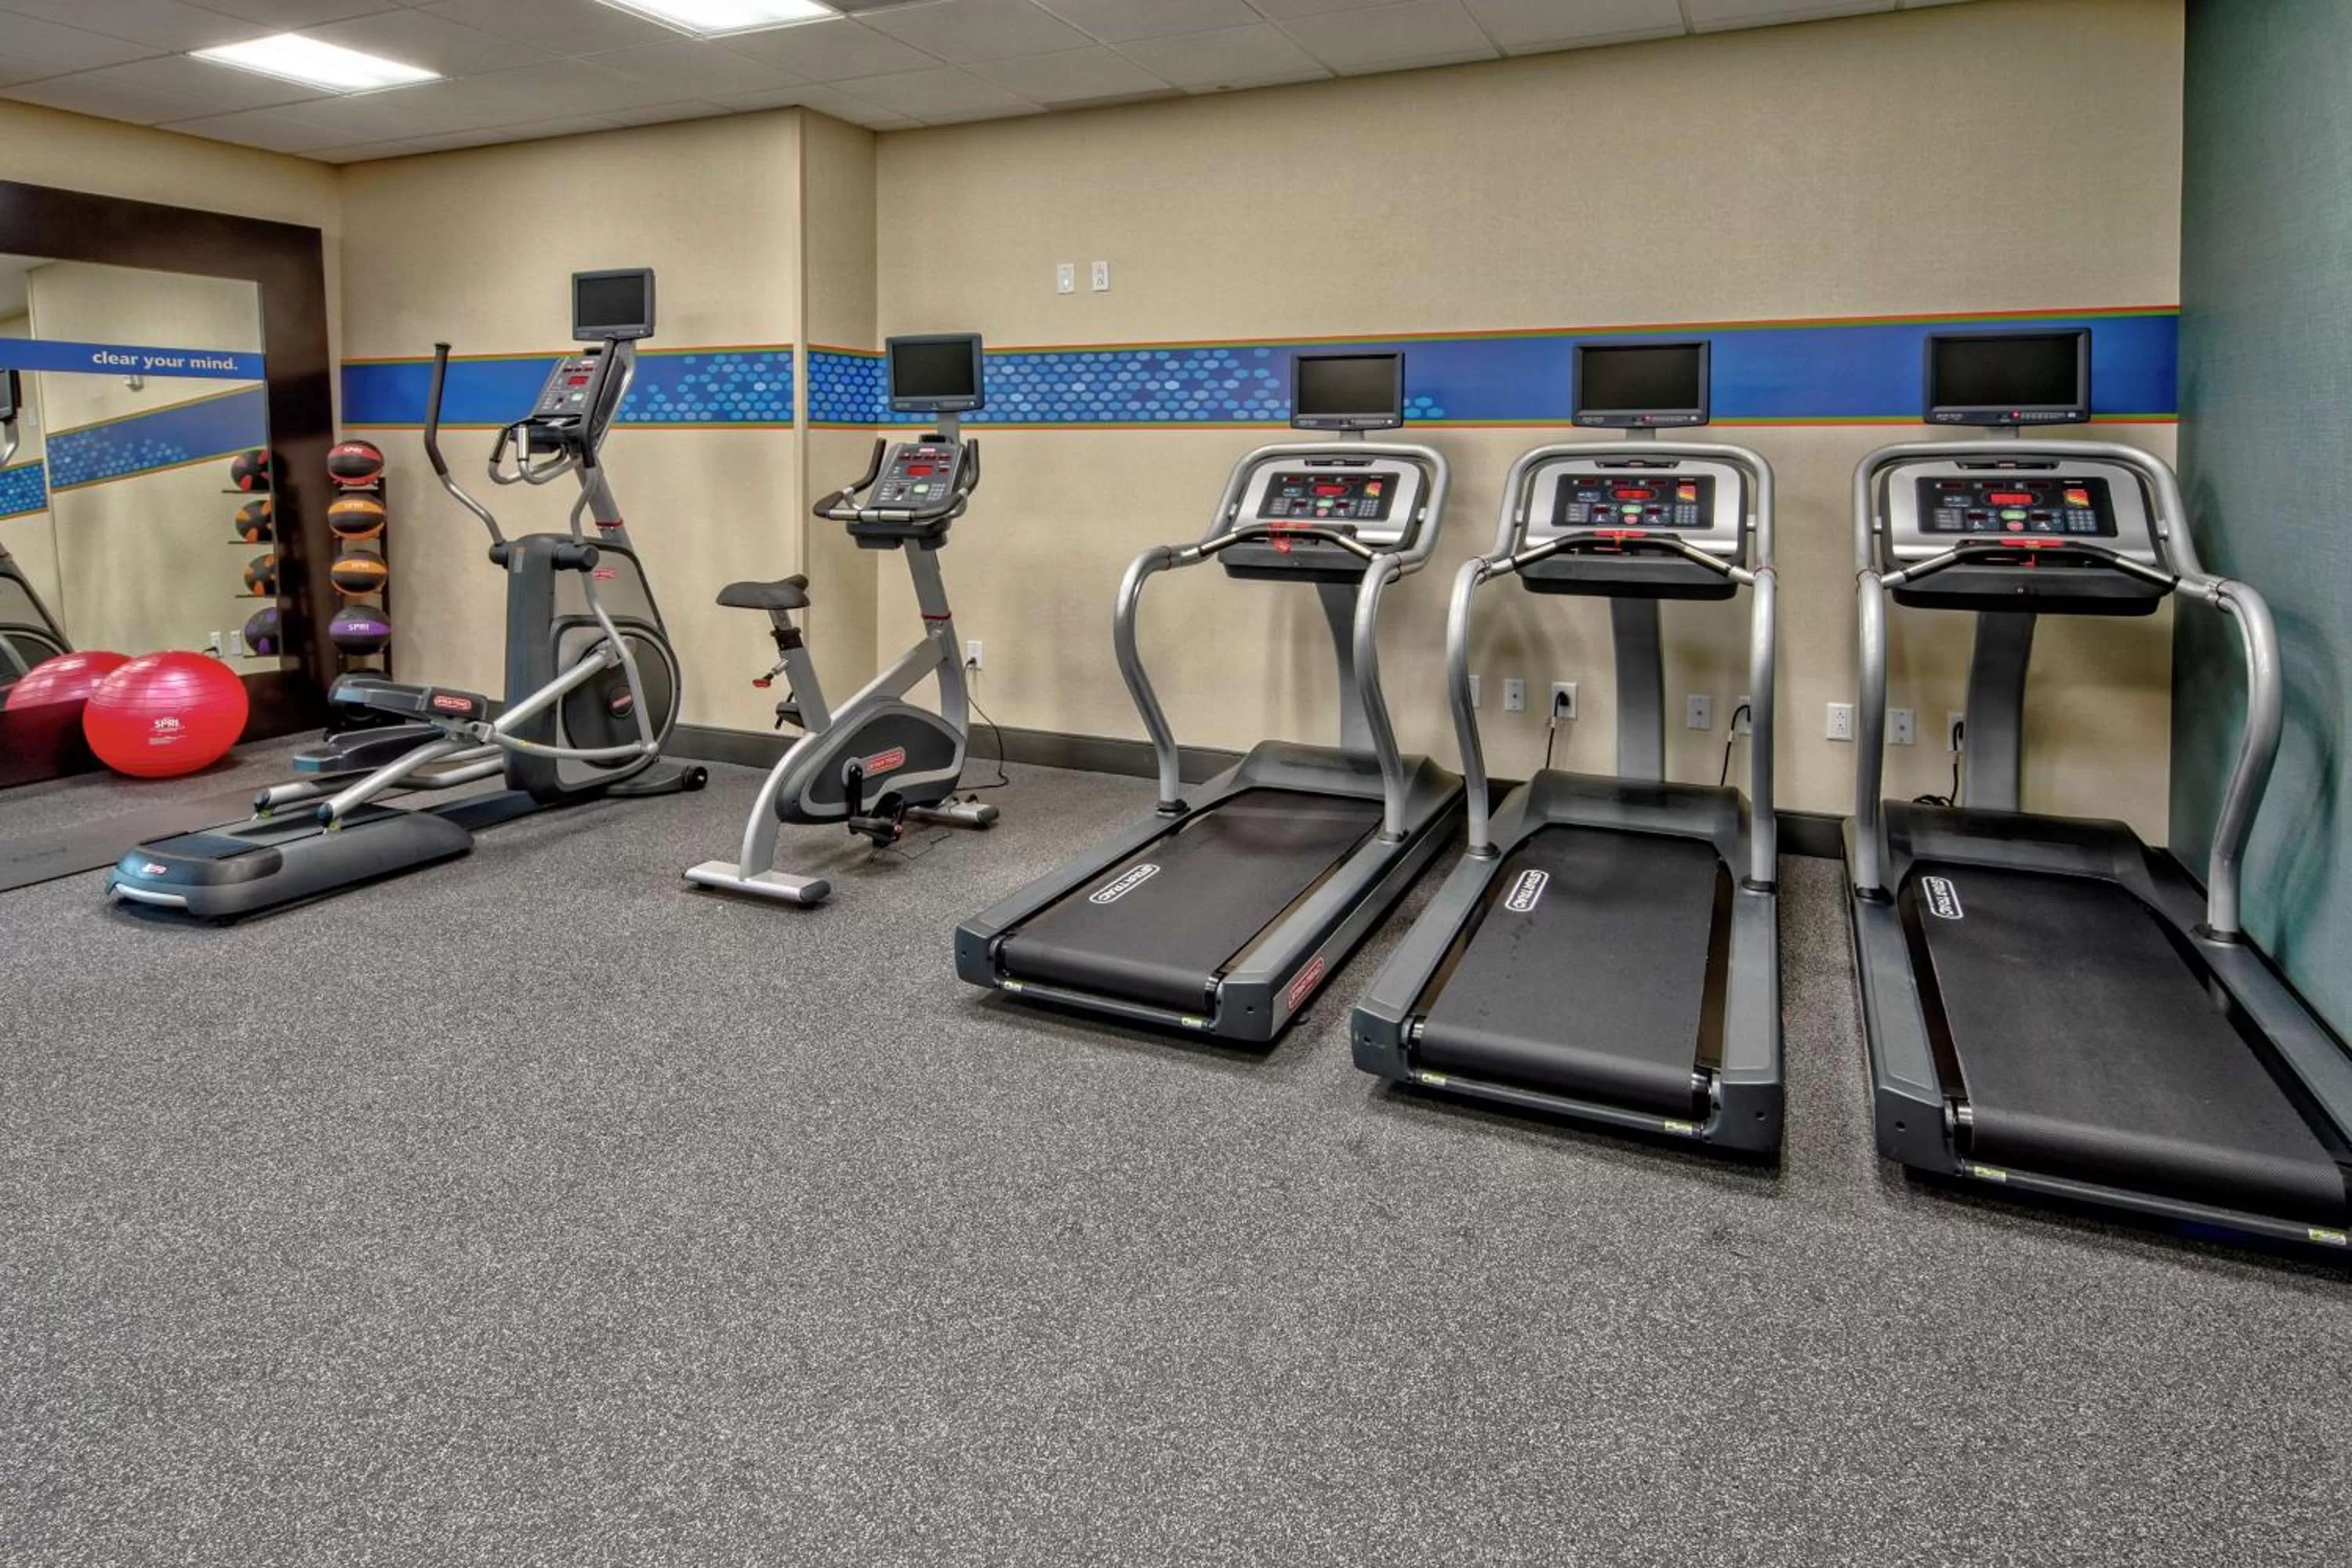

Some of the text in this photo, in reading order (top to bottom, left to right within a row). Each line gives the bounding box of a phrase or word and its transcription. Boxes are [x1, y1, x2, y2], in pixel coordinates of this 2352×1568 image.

[92, 350, 238, 371] clear your mind.
[154, 718, 180, 728] SPRI
[1513, 871, 1542, 908] STAR TRAC
